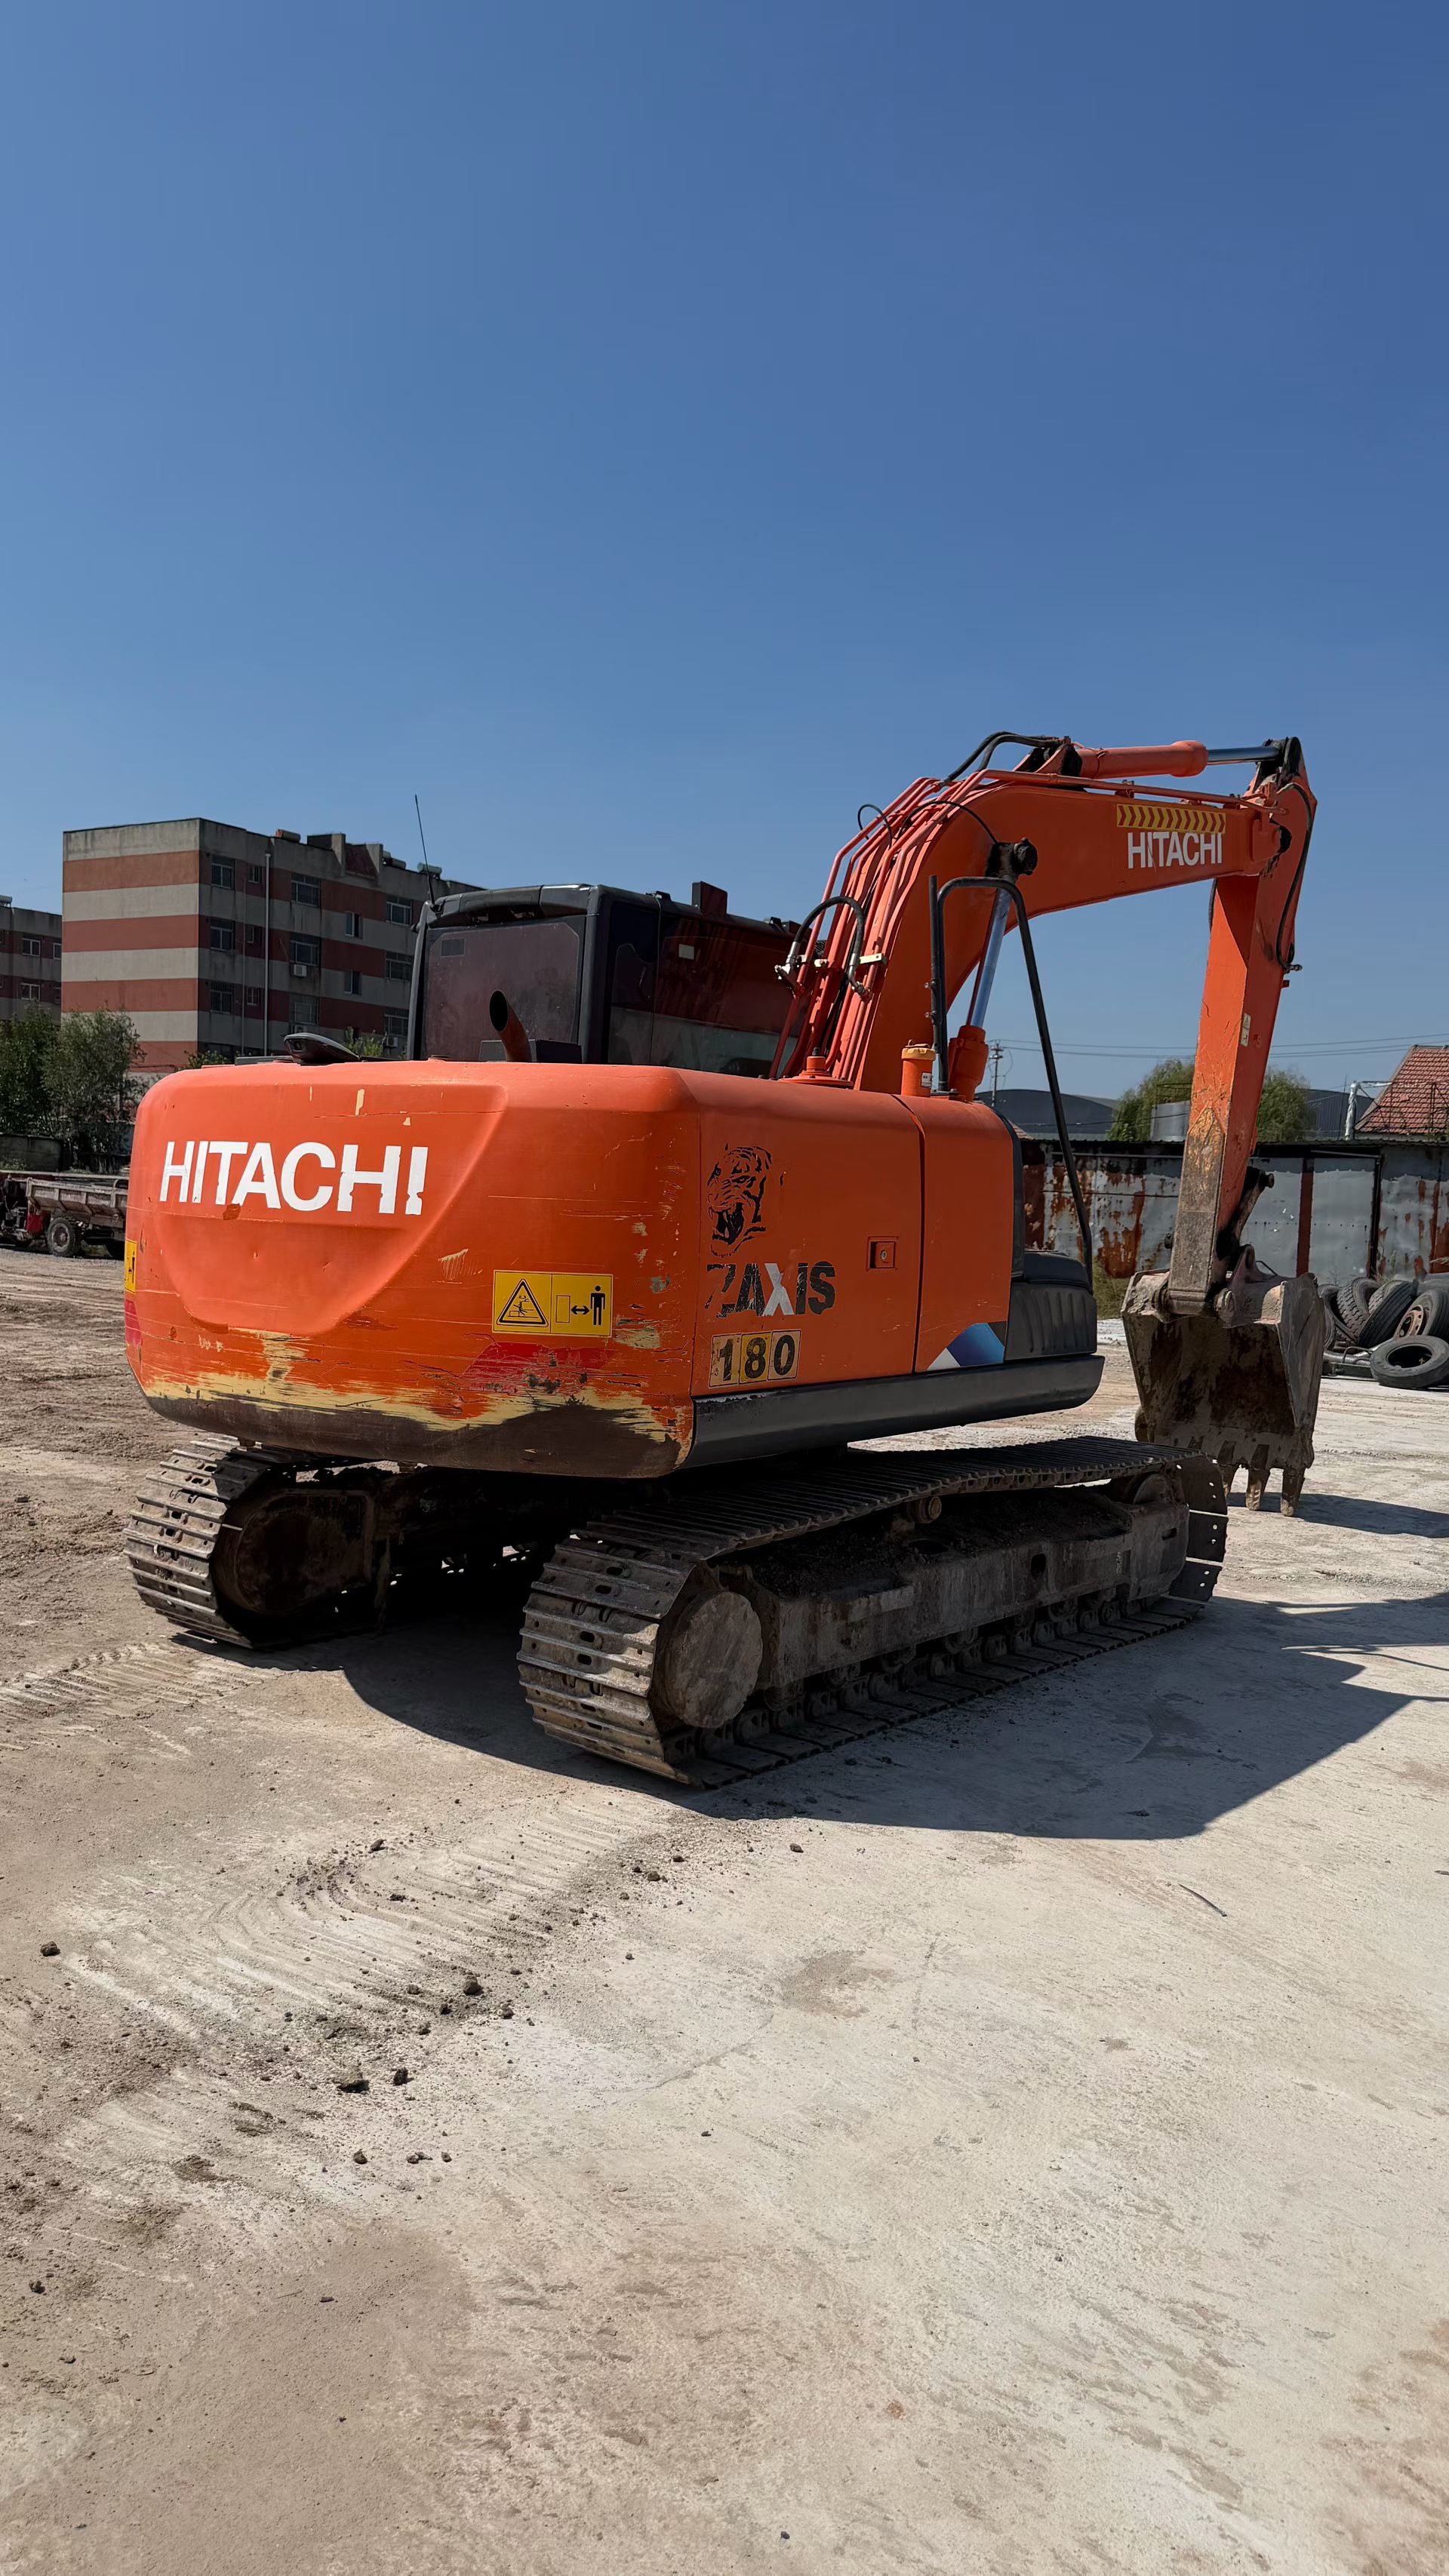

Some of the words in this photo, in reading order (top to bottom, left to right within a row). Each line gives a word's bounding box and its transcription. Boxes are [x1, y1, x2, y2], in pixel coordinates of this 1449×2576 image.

[1128, 832, 1222, 869] HITACHI
[159, 1141, 428, 1216] HITACHI
[719, 1334, 795, 1382] 180
